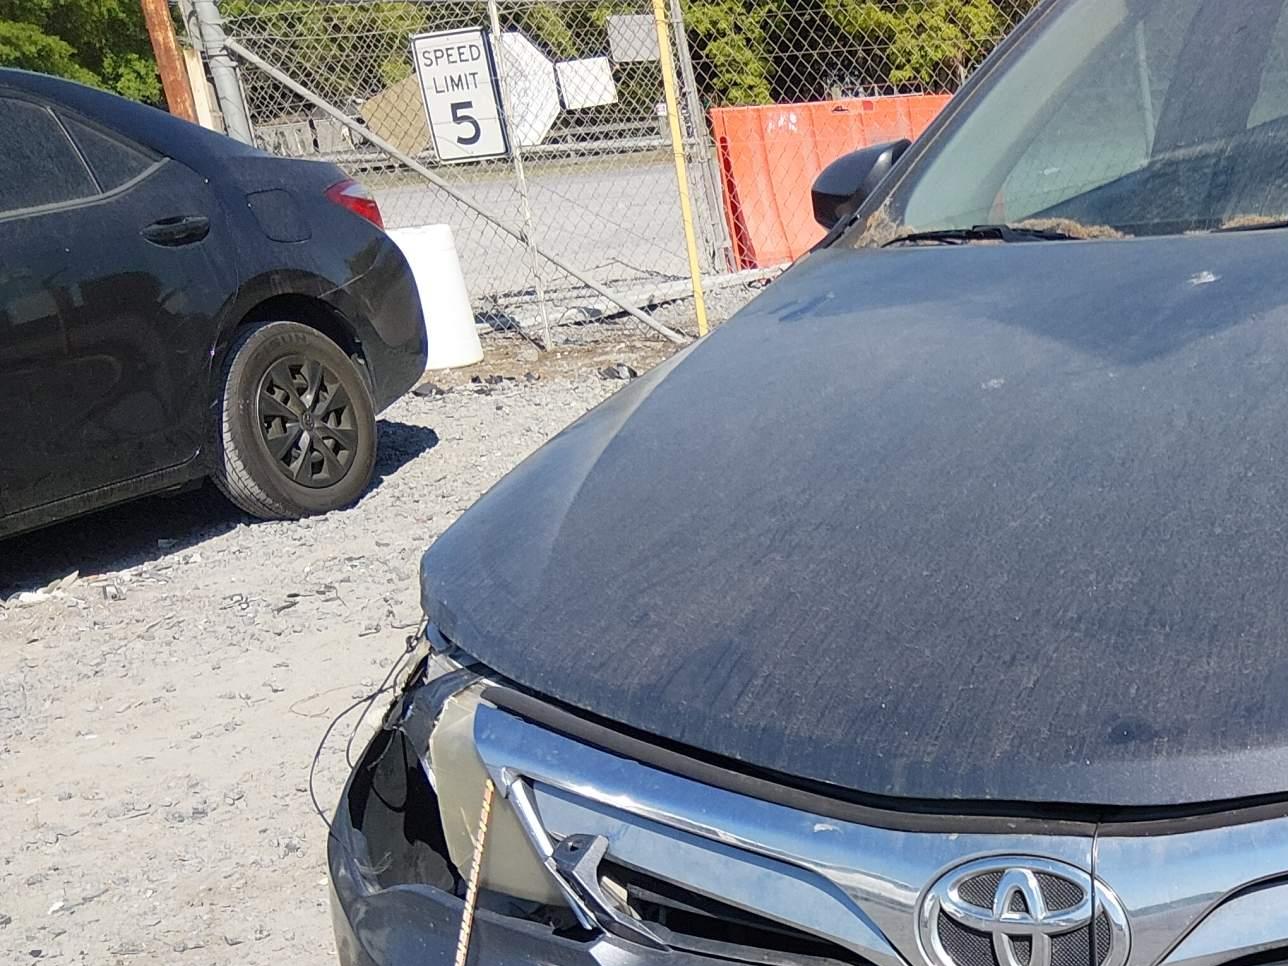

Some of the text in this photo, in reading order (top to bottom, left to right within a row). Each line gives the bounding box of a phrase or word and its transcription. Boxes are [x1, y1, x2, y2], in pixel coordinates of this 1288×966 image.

[422, 44, 481, 67] SPEED
[433, 72, 479, 94] LIMIT
[450, 100, 481, 145] 5
